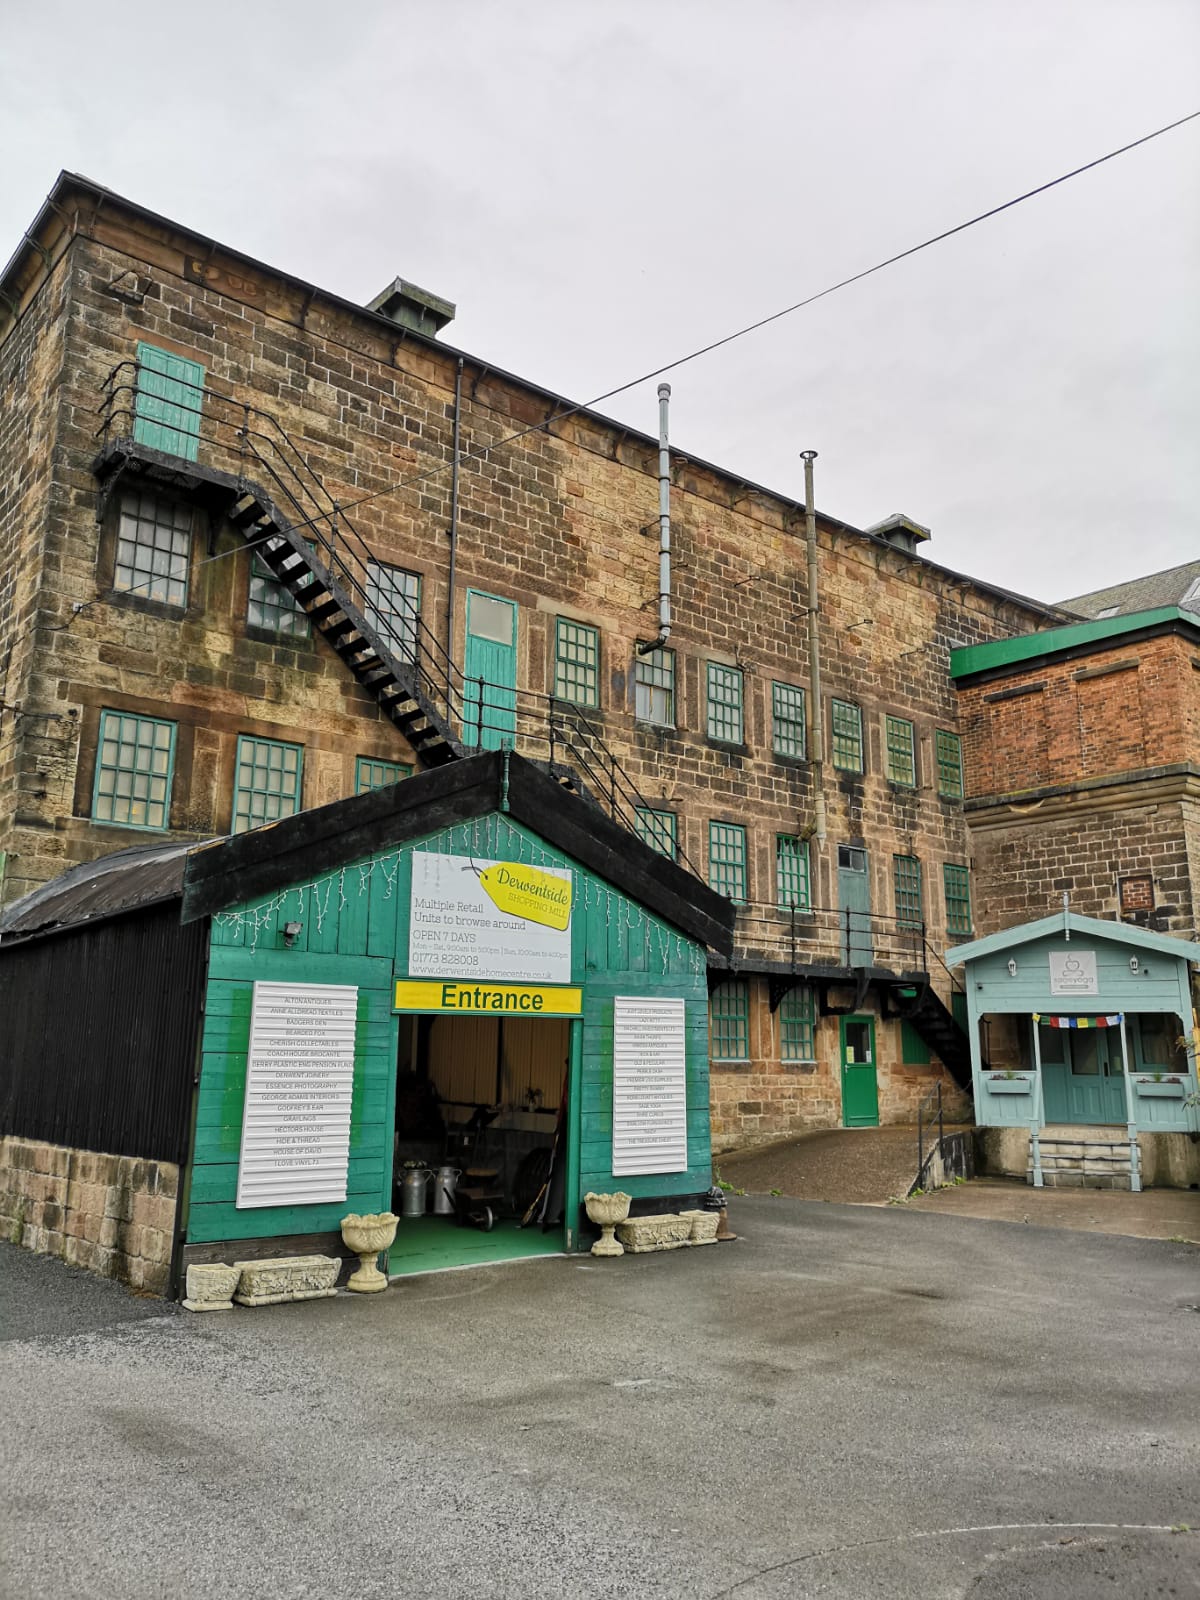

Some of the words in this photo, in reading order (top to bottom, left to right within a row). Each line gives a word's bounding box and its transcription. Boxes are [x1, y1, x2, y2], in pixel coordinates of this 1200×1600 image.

[496, 867, 568, 905] Derwentside
[415, 898, 455, 912] Multiple
[457, 901, 484, 913] Retail
[507, 892, 548, 912] SHOPPING
[549, 905, 567, 919] MILL
[414, 911, 441, 924] Units
[444, 914, 454, 925] to
[455, 915, 491, 928] browse
[492, 919, 526, 930] around
[412, 929, 441, 941] OPEN
[442, 931, 449, 941] 7
[451, 931, 477, 943] DAYS
[412, 951, 439, 964] 01773
[441, 953, 479, 966] 828008
[441, 984, 544, 1010] Entrance
